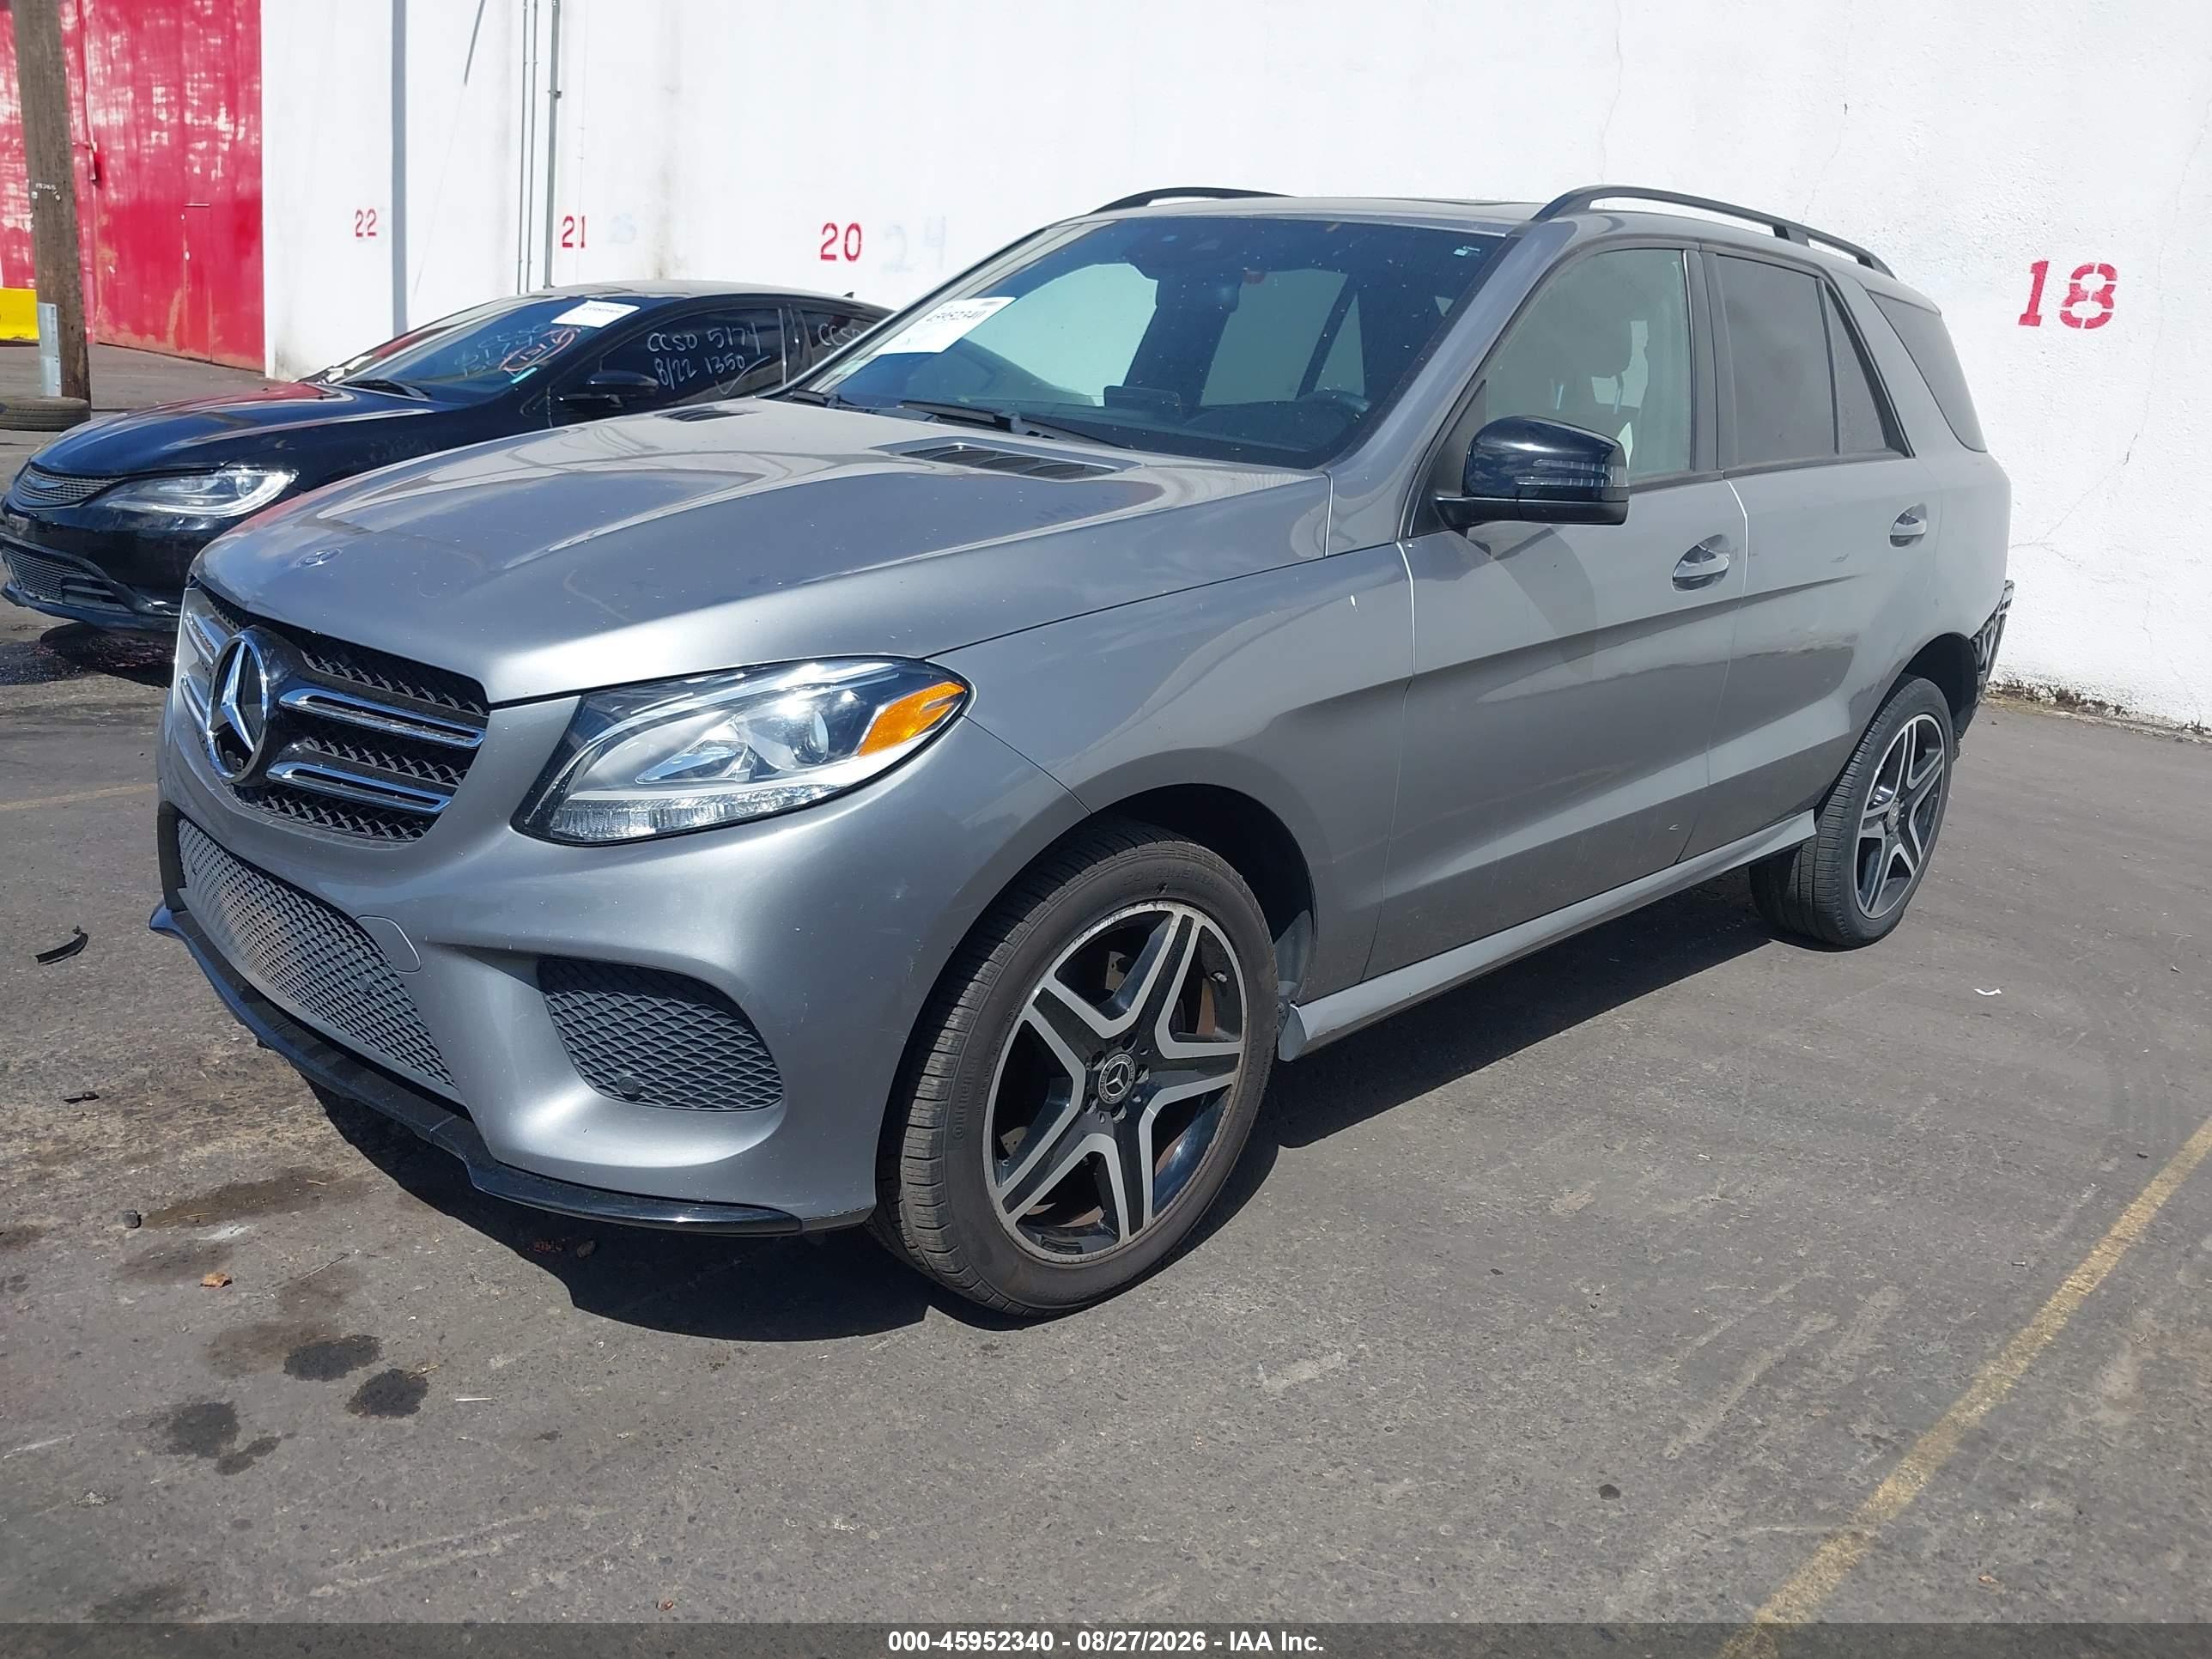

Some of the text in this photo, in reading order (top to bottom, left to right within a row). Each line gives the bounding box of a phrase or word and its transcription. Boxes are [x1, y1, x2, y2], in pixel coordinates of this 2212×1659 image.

[355, 209, 378, 237] 22
[561, 216, 586, 248] 21
[820, 222, 862, 262] 20
[2017, 259, 2119, 330] 18
[707, 321, 761, 356] 5174
[654, 352, 746, 390] 8/22 1350
